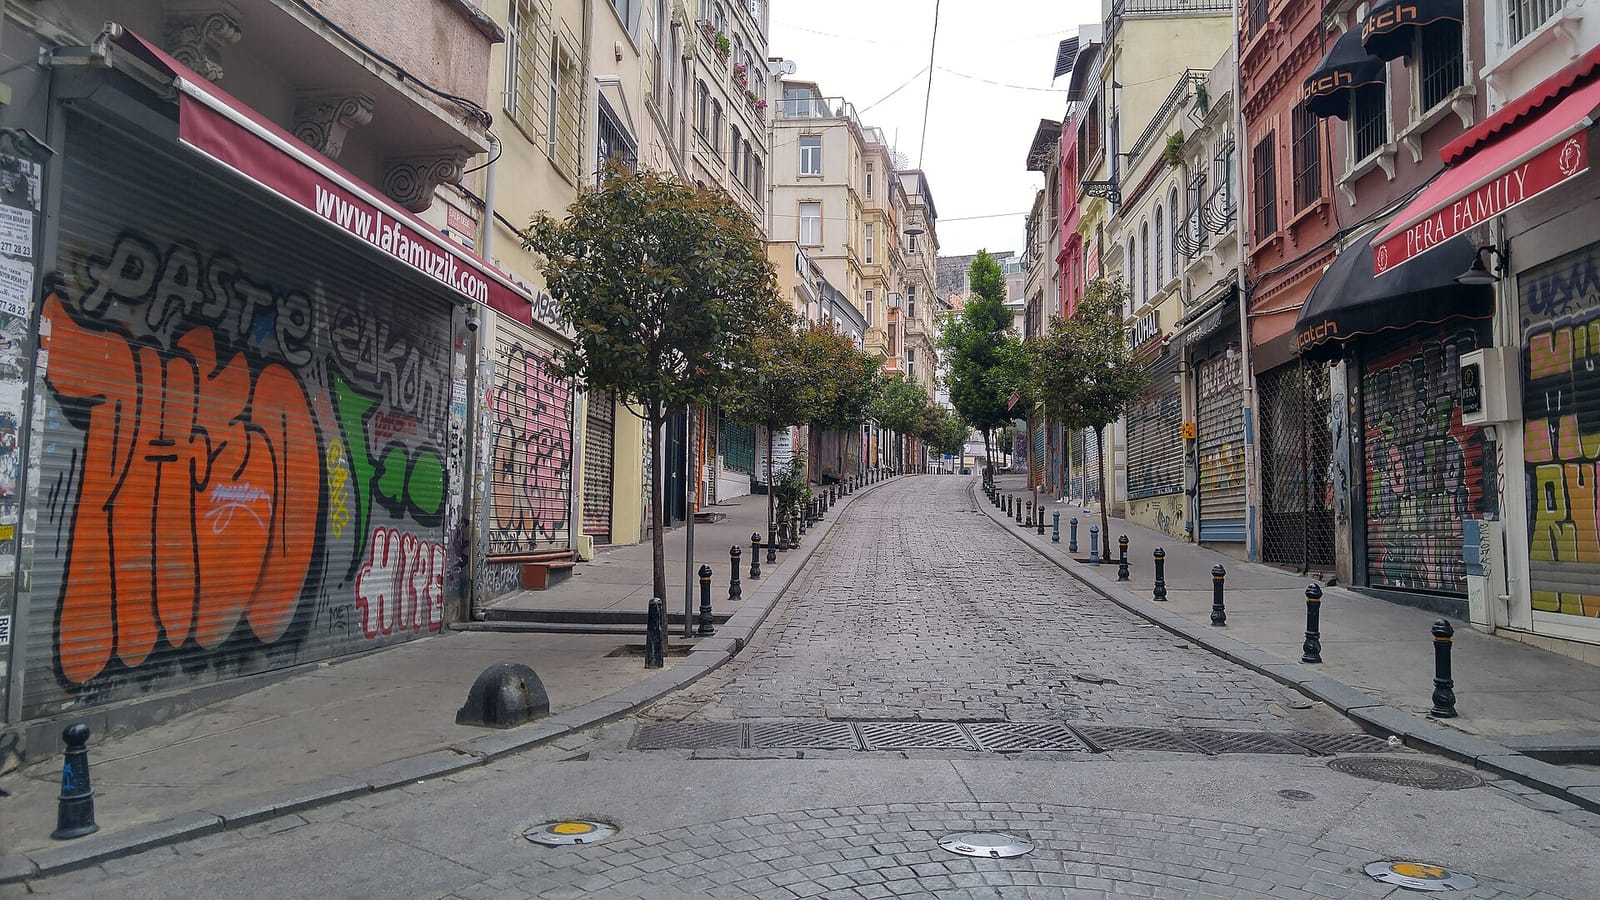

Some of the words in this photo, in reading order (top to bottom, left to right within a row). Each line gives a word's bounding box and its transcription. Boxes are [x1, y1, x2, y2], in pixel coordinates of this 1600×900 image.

[1406, 213, 1447, 258] PERA
[1453, 163, 1530, 234] FAMILY
[1, 241, 12, 251] 277
[14, 244, 21, 254] 28
[23, 246, 30, 256] 23
[315, 184, 489, 304] www.lafamuzik.com
[8, 303, 16, 312] 28
[17, 306, 26, 316] 23
[1132, 310, 1158, 349] ZUHAL
[1462, 387, 1477, 399] PERA
[355, 526, 447, 640] HYPE
